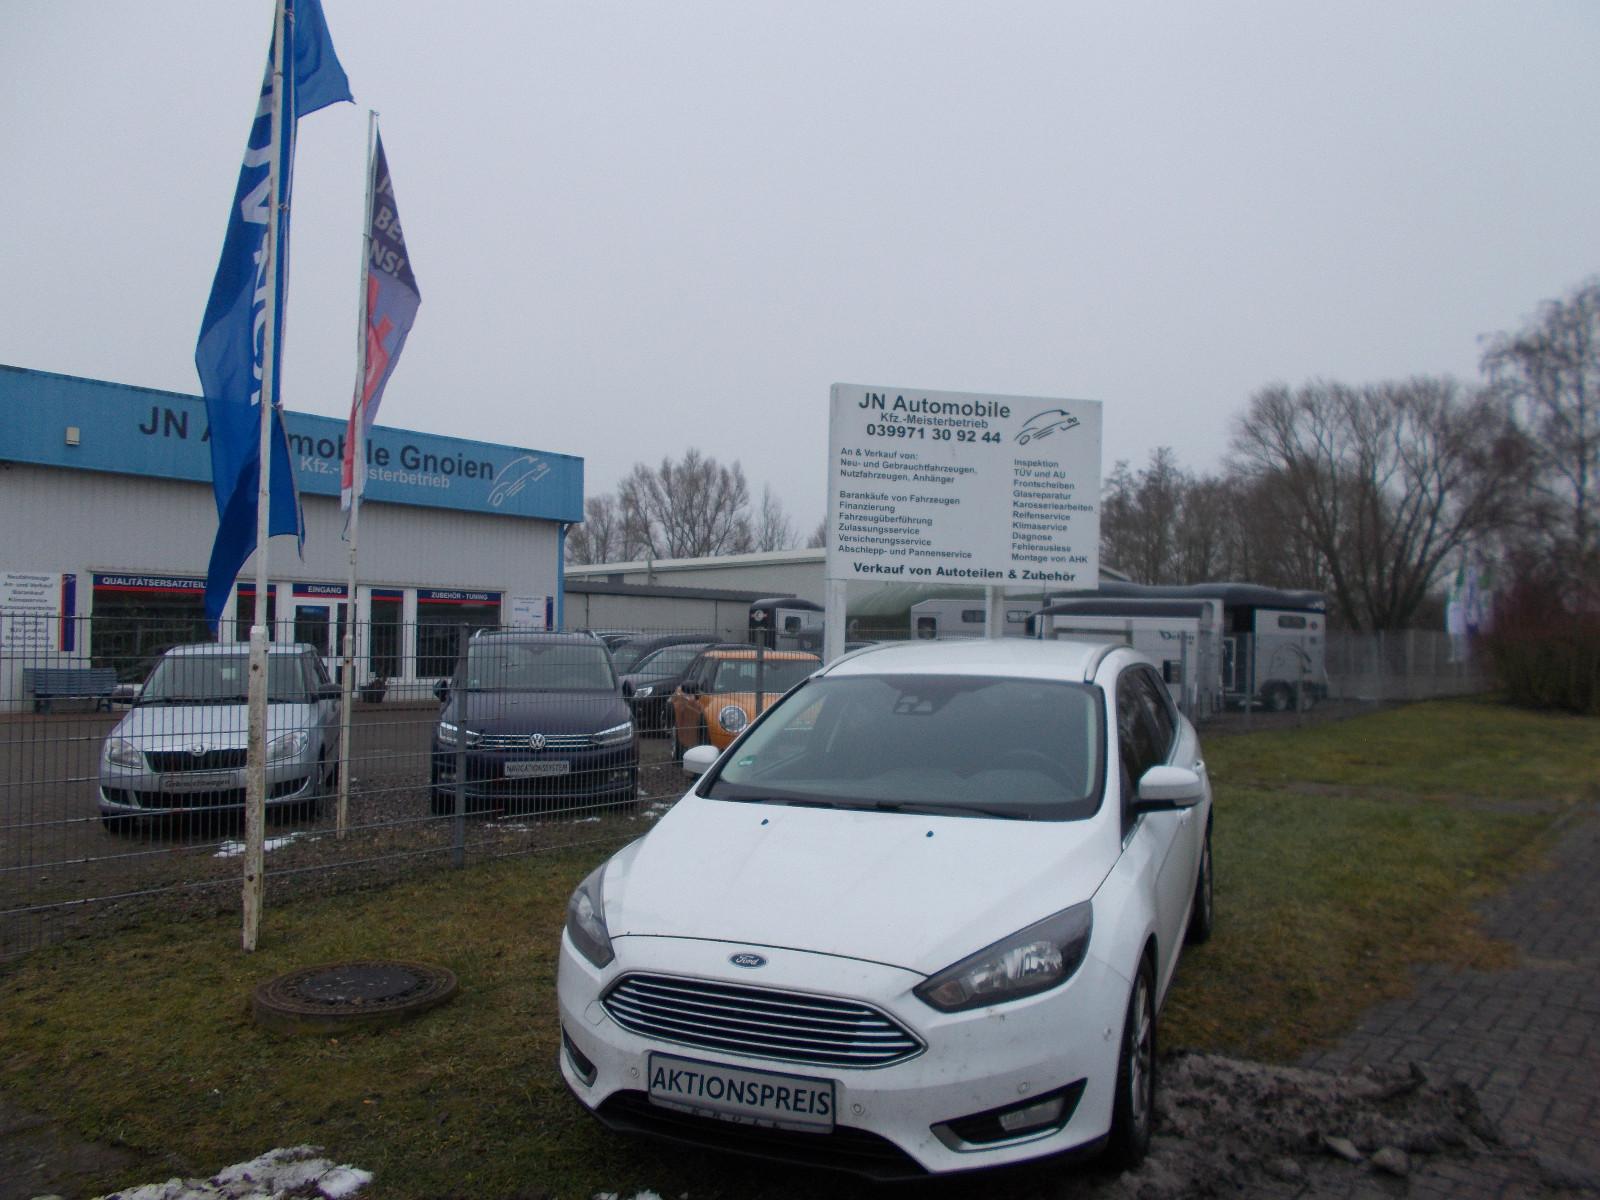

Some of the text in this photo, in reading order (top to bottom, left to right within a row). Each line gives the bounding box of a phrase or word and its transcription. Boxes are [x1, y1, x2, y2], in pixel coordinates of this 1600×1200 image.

[859, 393, 1010, 419] JN Automobile
[880, 413, 988, 429] Kfz.-Meisterbetrieb
[866, 424, 1002, 444] 039971 30 92 44
[139, 406, 188, 439] JN
[400, 445, 493, 480] Gnoien
[841, 448, 918, 460] An & Verkauf von:
[840, 459, 861, 467] Neu-
[863, 460, 880, 469] und
[1014, 459, 1060, 469] Inspektion
[913, 474, 955, 484] Anhänger
[1014, 468, 1067, 479] TÜV und AU
[1013, 479, 1075, 490] Frontscheiben
[839, 490, 889, 501] Barankäufe
[910, 494, 960, 506] Fahrzeugen
[1013, 490, 1071, 501] Glasreparatur
[839, 501, 896, 513] Finanzierung
[1013, 501, 1094, 512] Karosseriearbeiten
[839, 512, 933, 526] Fahrzeugüberführung
[1012, 511, 1071, 521] Reifenservice
[838, 523, 920, 535] Zulassungsservice
[1012, 521, 1068, 531] Klimaservice
[838, 534, 932, 546] Versicherungsservice
[1012, 532, 1053, 541] Diagnose
[838, 545, 972, 559] Abschlepp- und Pannenservice
[1012, 543, 1071, 552] Fehlerauslese
[1011, 553, 1048, 564] Montage
[1050, 555, 1066, 563] von
[853, 562, 1077, 582] Verkauf von Autoteilen & Zubehör
[102, 576, 208, 589] QUALITÄTSERSATZTEIL
[307, 585, 342, 594] EINGANG
[431, 591, 461, 600] ZUBEHÖR
[735, 955, 760, 966] Ford
[651, 1066, 831, 1116] AKTIONSPREIS
